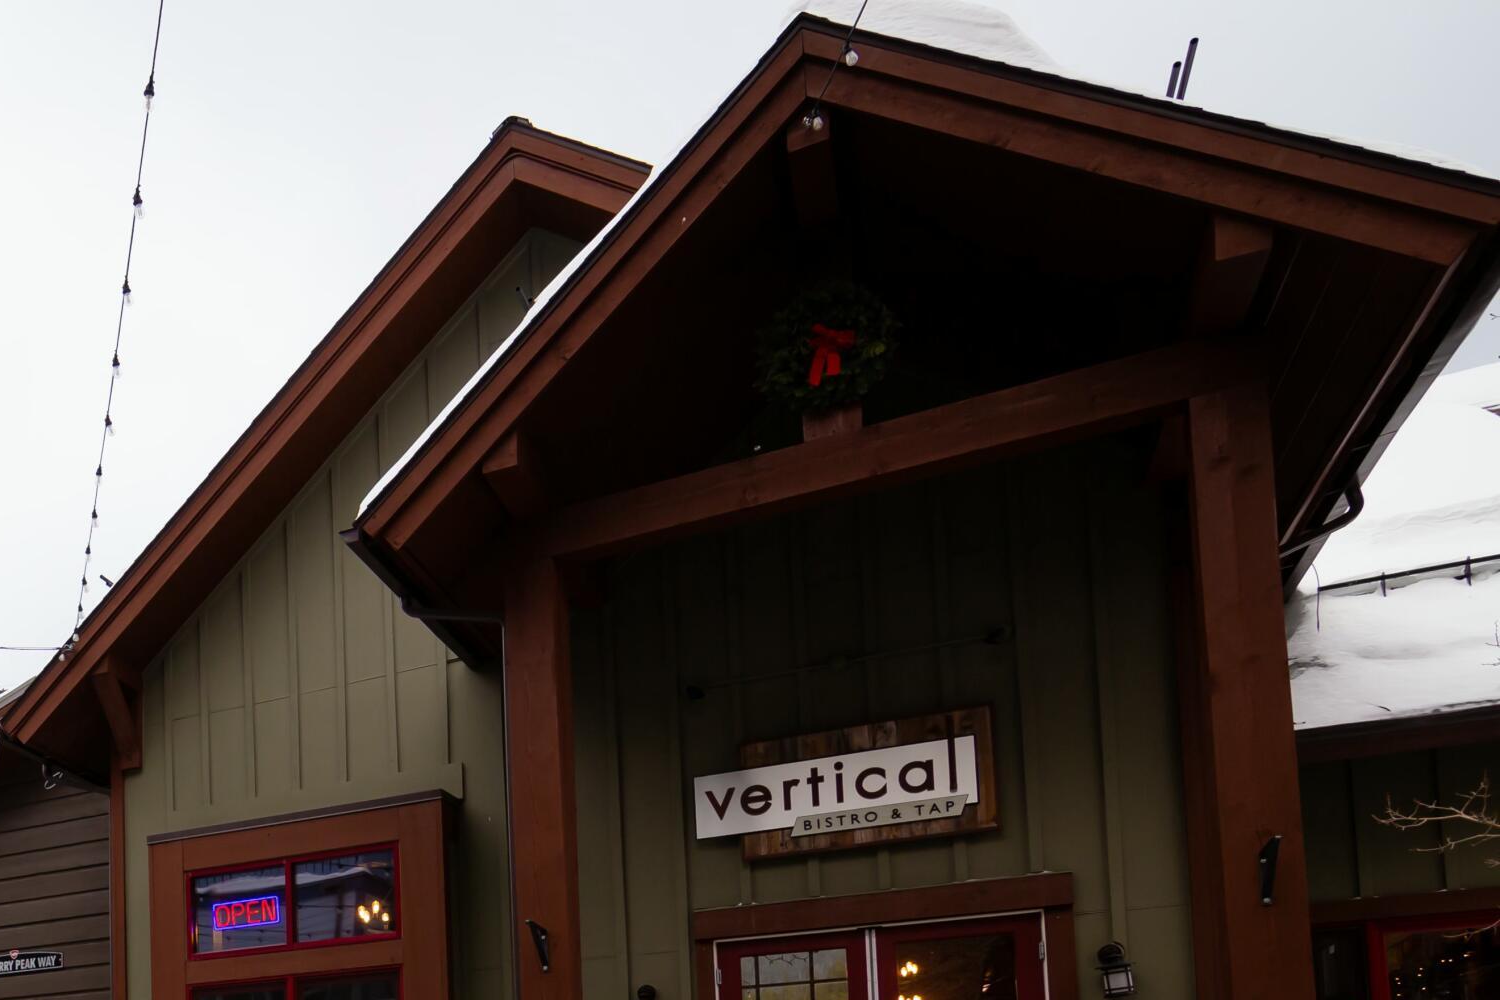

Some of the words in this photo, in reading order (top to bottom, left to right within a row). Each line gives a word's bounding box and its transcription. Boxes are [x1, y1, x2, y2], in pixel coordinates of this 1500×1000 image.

[704, 715, 958, 821] vertical
[803, 811, 879, 831] BISTRO
[891, 808, 902, 819] &
[914, 801, 956, 817] TAP
[215, 899, 277, 928] OPEN
[15, 958, 37, 970] PEAK
[37, 955, 57, 967] WAY
